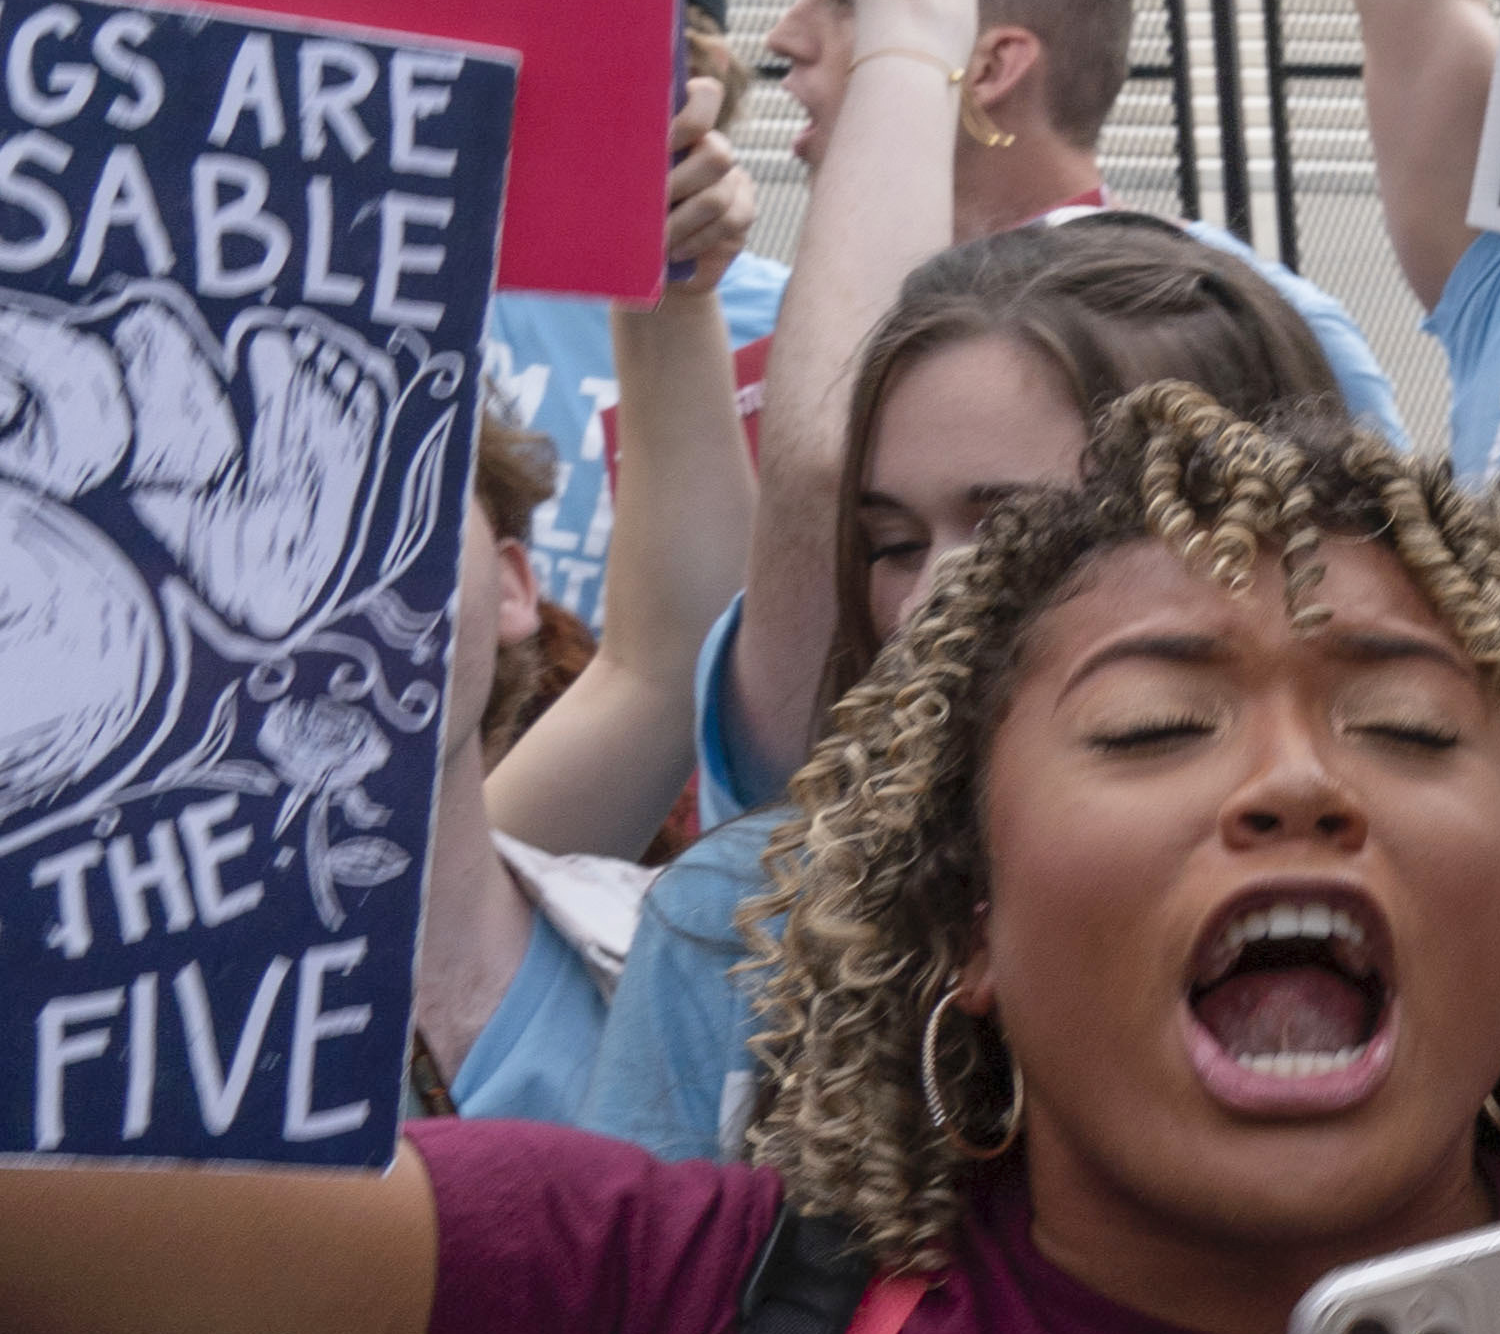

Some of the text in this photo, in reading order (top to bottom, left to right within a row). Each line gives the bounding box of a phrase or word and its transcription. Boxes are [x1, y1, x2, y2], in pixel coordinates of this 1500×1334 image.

[208, 33, 467, 178] ARE
[31, 791, 265, 960] THE
[34, 939, 371, 1152] FIVE
